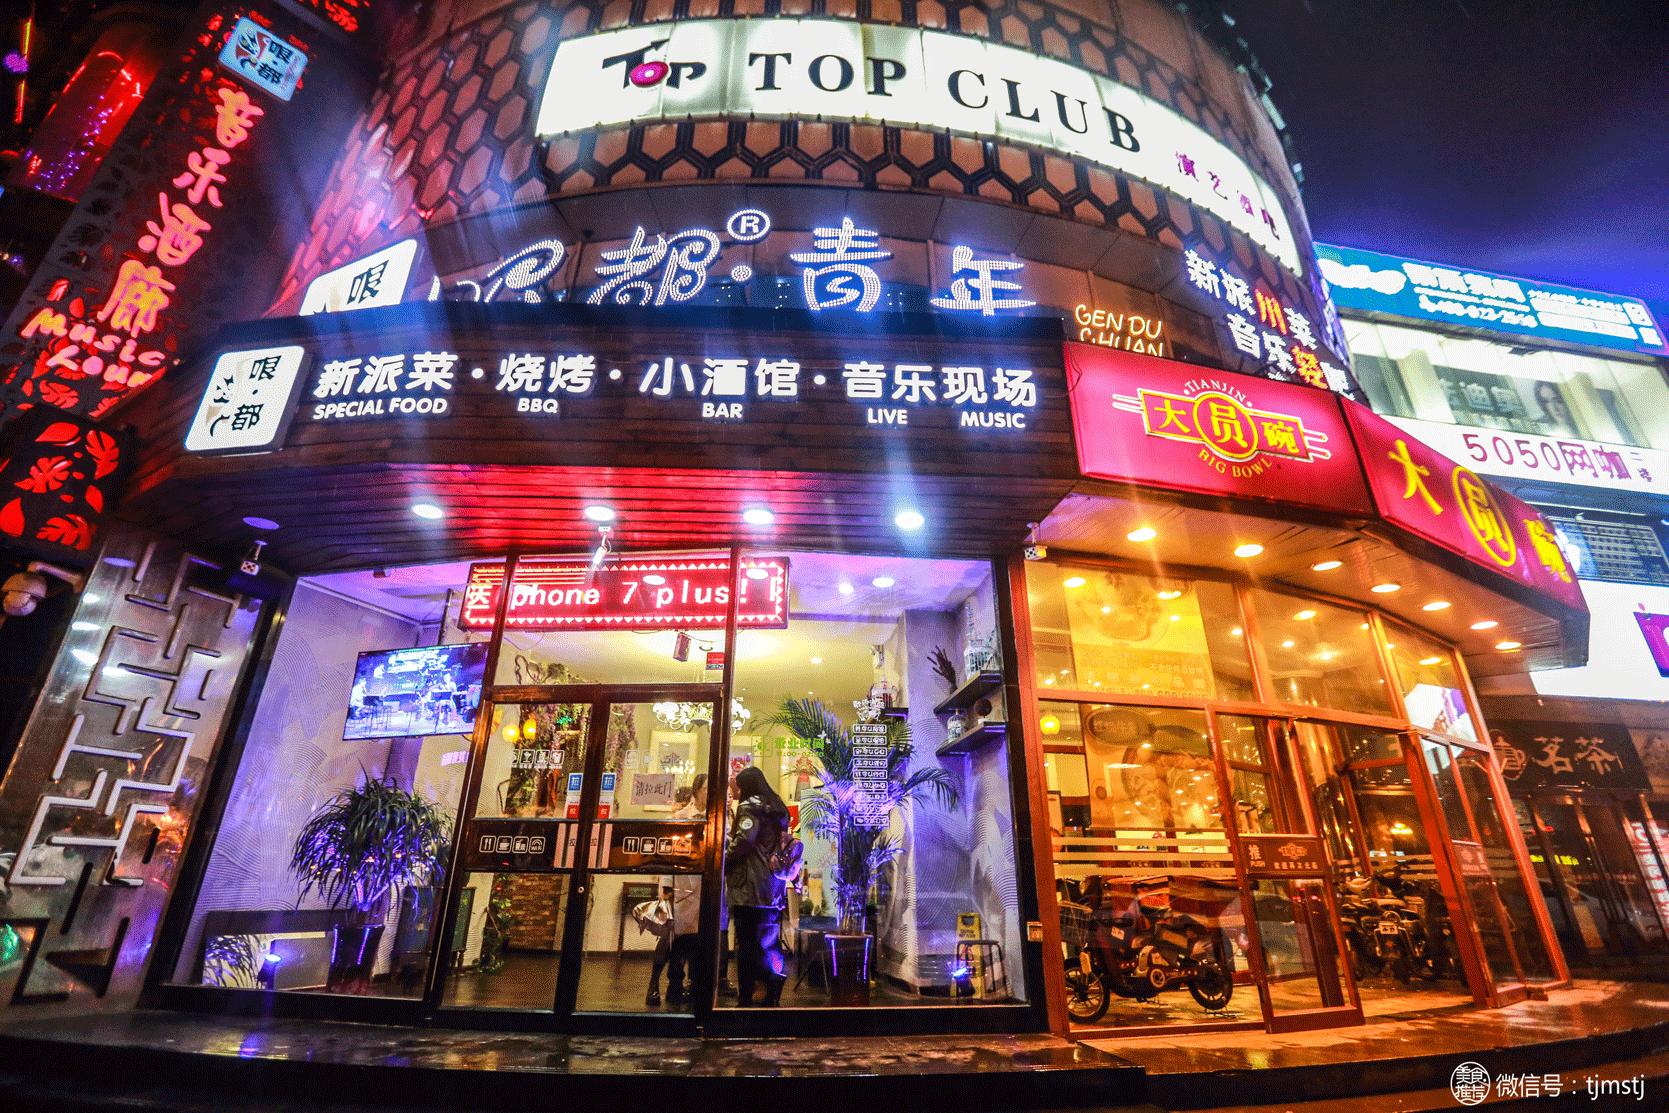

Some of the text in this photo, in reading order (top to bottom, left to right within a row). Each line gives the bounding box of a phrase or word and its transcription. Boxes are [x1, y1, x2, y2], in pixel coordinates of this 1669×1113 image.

[748, 53, 1140, 153] TOP CLUB
[1075, 303, 1162, 339] GEN DU
[312, 350, 1038, 407] 新派菜 烧烤 小酒馆 音乐现场
[1185, 378, 1247, 402] TIANJIN
[312, 396, 1027, 429] SPECIAL FOOD BBQ BAR LIVE MUSIC
[1154, 399, 1301, 454] 大员碗
[1198, 448, 1273, 479] BIG BOWL
[621, 581, 640, 605] 7
